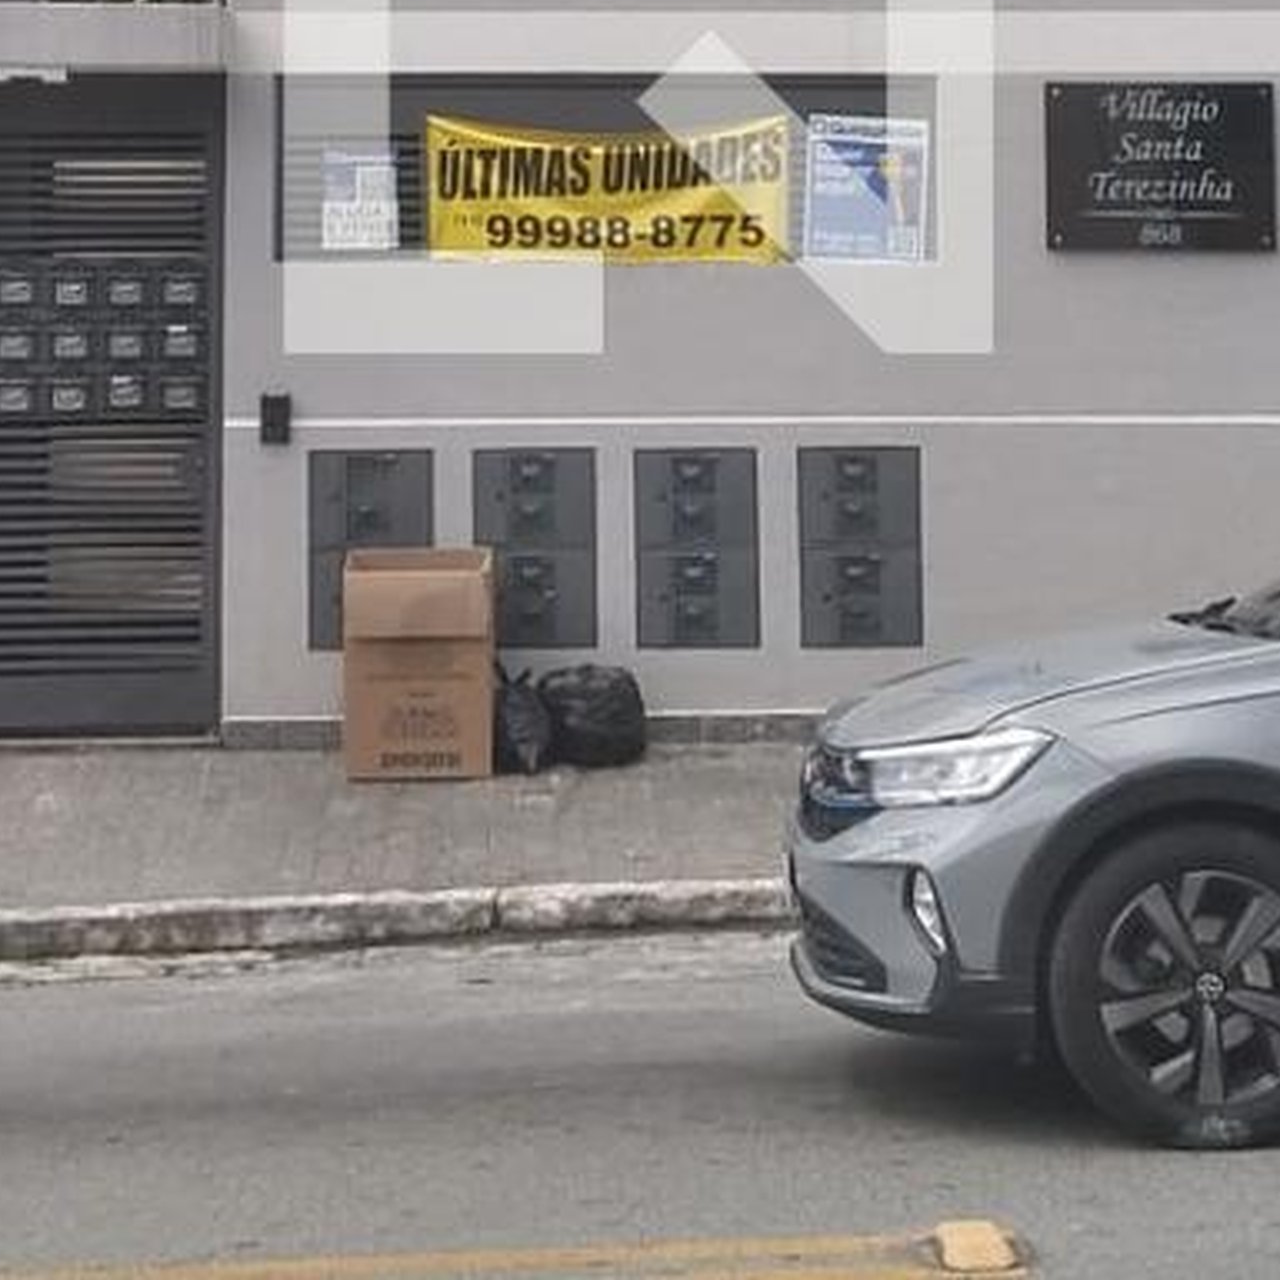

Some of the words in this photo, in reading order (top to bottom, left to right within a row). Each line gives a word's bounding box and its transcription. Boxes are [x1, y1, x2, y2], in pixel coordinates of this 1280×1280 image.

[1101, 87, 1219, 131] Villagio
[1112, 131, 1202, 163] Santa
[439, 138, 590, 200] ÚLTIMAS
[603, 130, 785, 194] UNIDADES
[1088, 167, 1232, 201] Terezinha
[486, 214, 766, 248] 99988-8775
